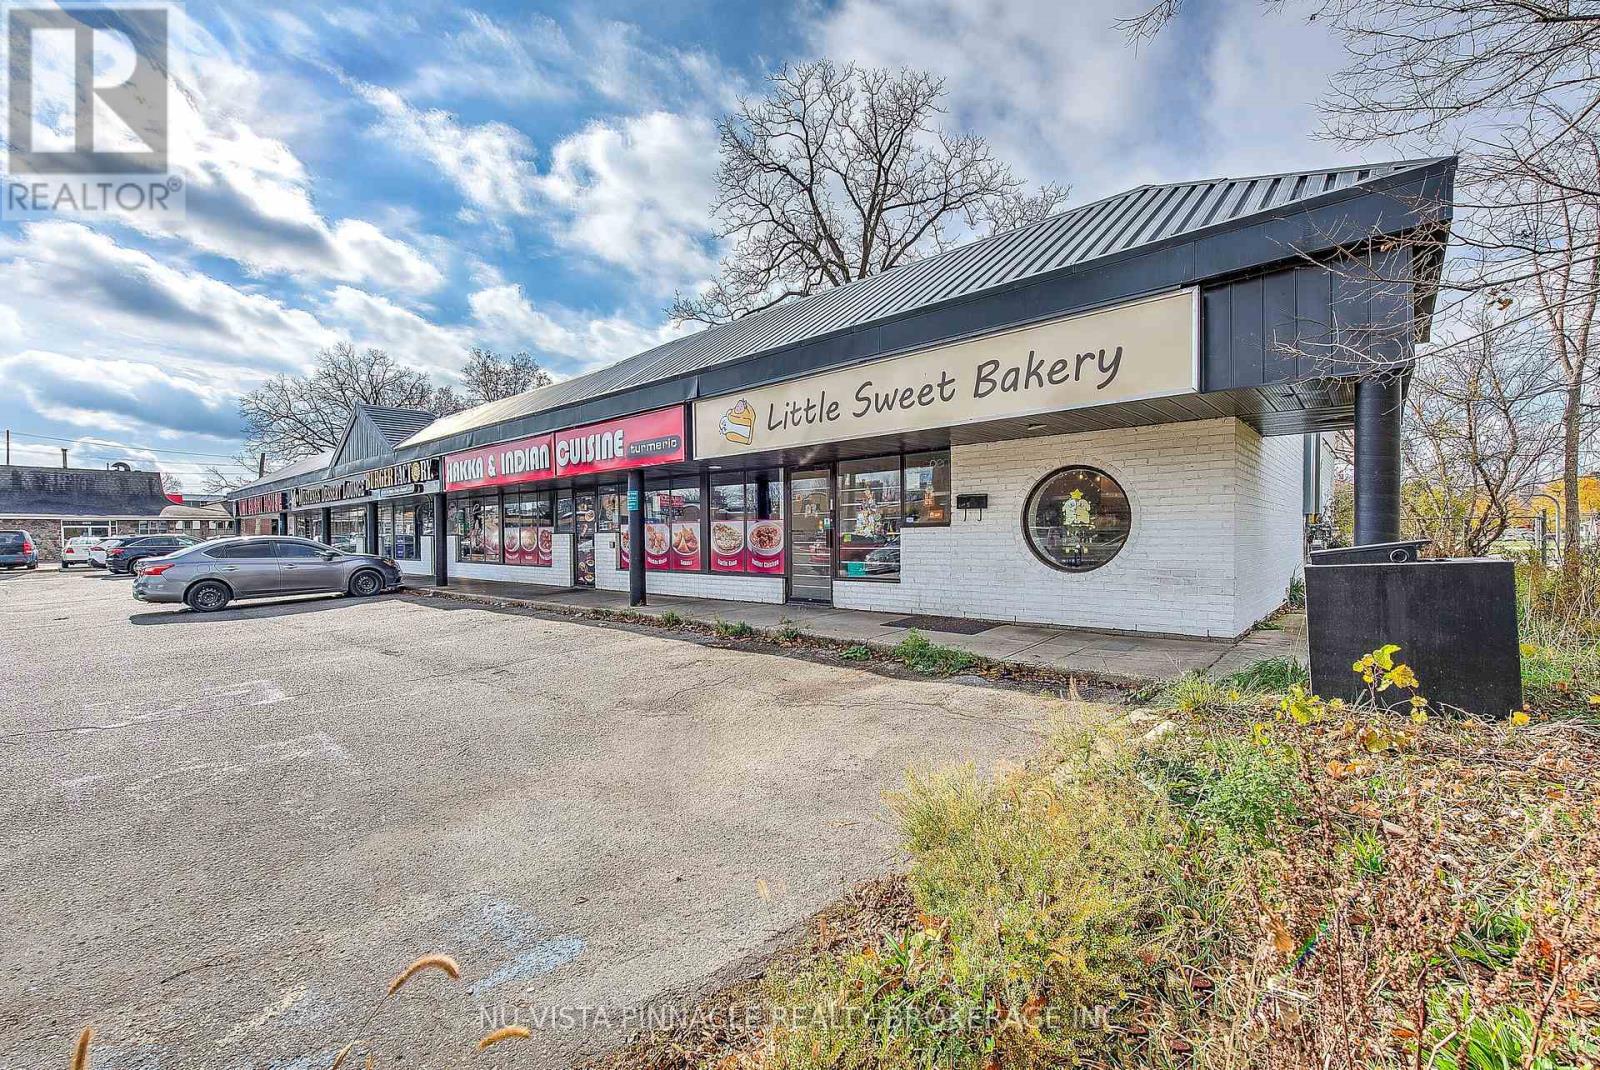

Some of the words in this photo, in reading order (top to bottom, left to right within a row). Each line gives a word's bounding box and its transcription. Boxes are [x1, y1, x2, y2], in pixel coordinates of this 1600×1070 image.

[766, 391, 842, 431] Little
[853, 370, 956, 418] Sweet
[974, 344, 1124, 400] Bakery
[446, 456, 484, 483] HAKKA
[487, 454, 497, 477] &
[501, 443, 550, 475] INDIAN
[556, 429, 624, 467] CUISINE
[630, 437, 678, 454] turmeric
[365, 466, 393, 490] BURGER
